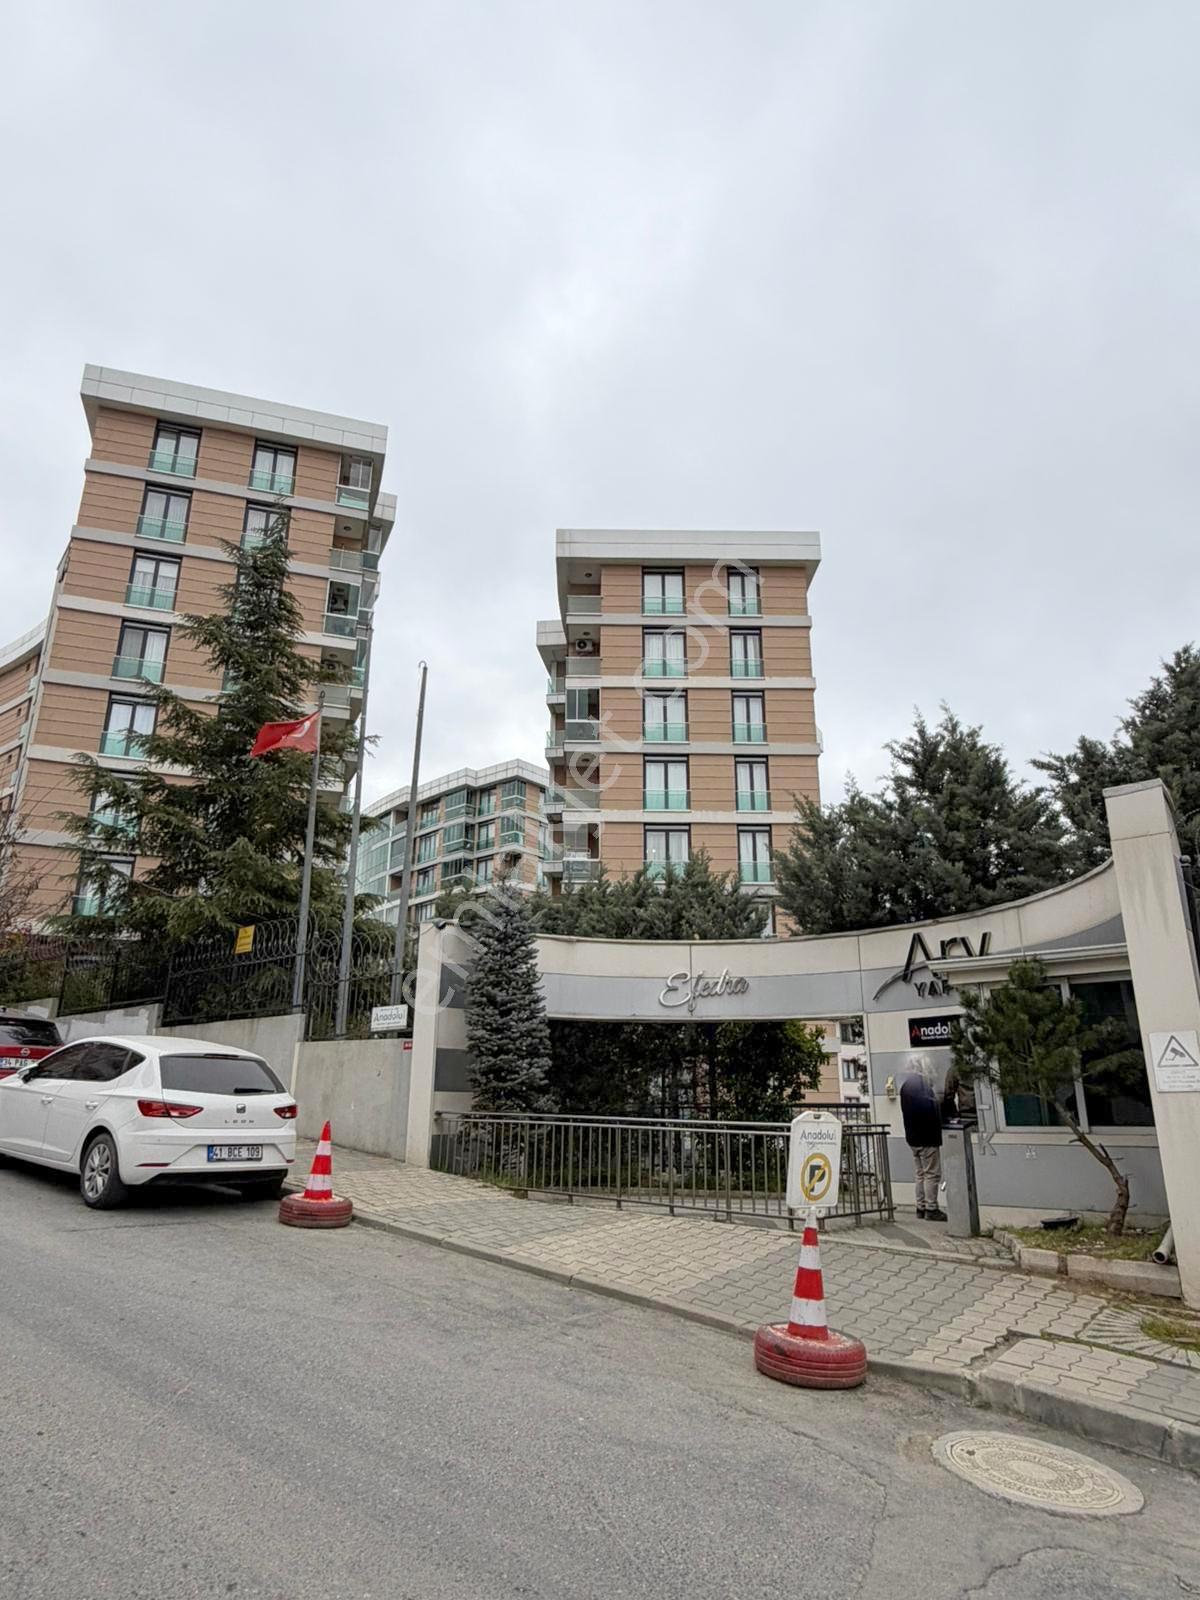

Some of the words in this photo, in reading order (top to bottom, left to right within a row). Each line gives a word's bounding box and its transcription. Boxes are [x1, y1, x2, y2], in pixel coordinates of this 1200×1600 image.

[659, 969, 749, 1016] Efedra
[911, 1021, 953, 1037] Anadol
[800, 1129, 835, 1141] Anadolu
[227, 1146, 243, 1158] BCE
[246, 1145, 260, 1157] 109
